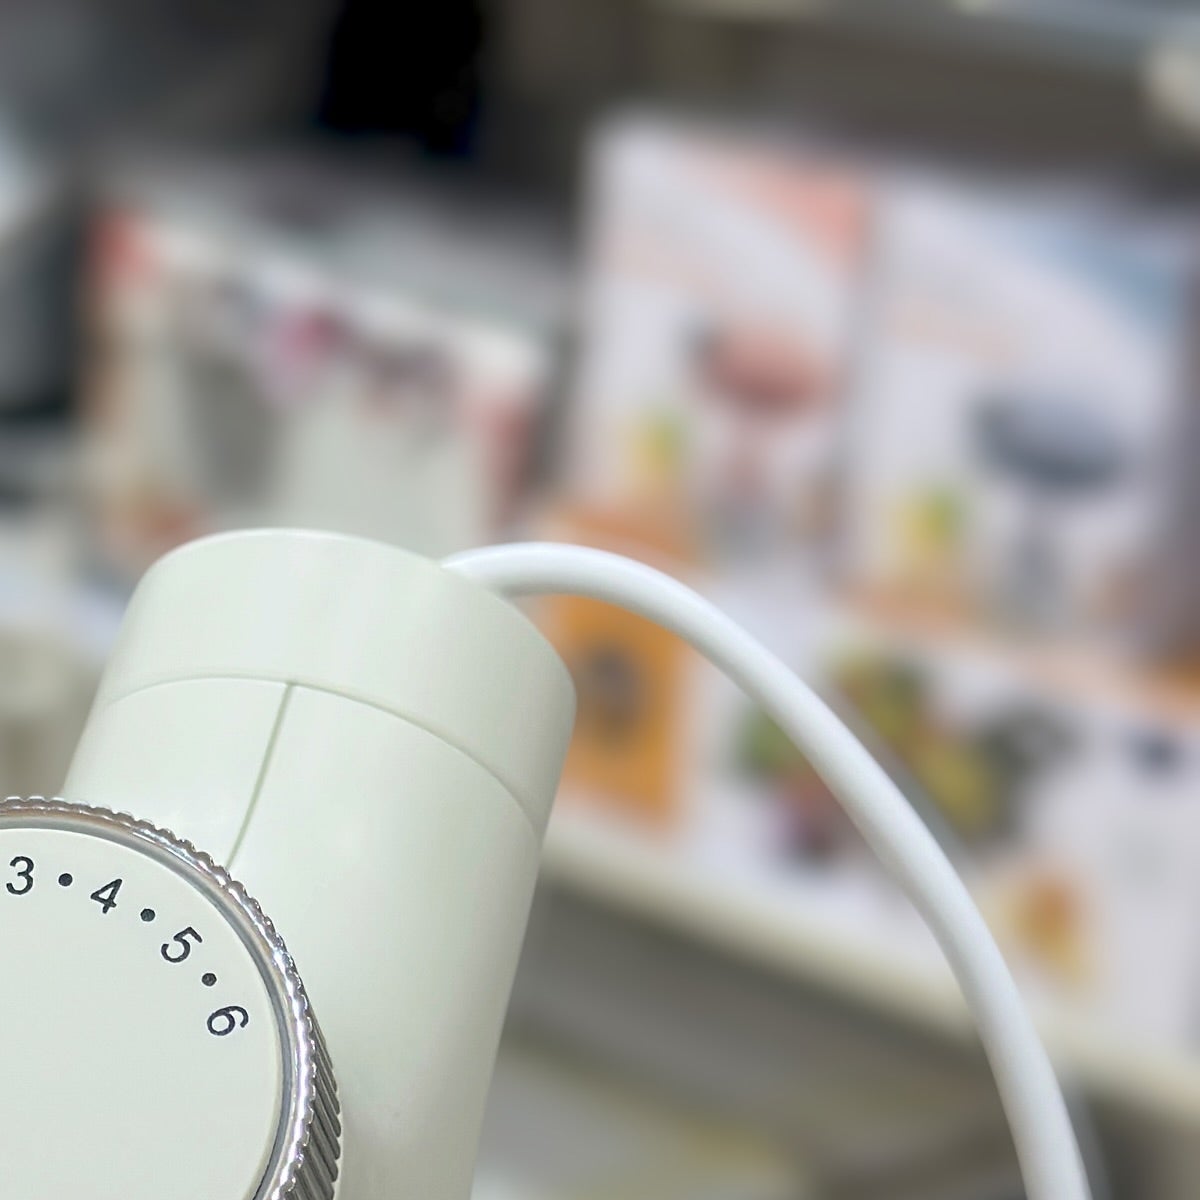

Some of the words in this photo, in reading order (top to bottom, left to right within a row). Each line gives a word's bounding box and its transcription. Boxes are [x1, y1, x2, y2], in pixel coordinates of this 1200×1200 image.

[5, 854, 36, 897] 3
[89, 877, 124, 915] 4
[159, 925, 204, 965] 5
[205, 1004, 250, 1037] 6
